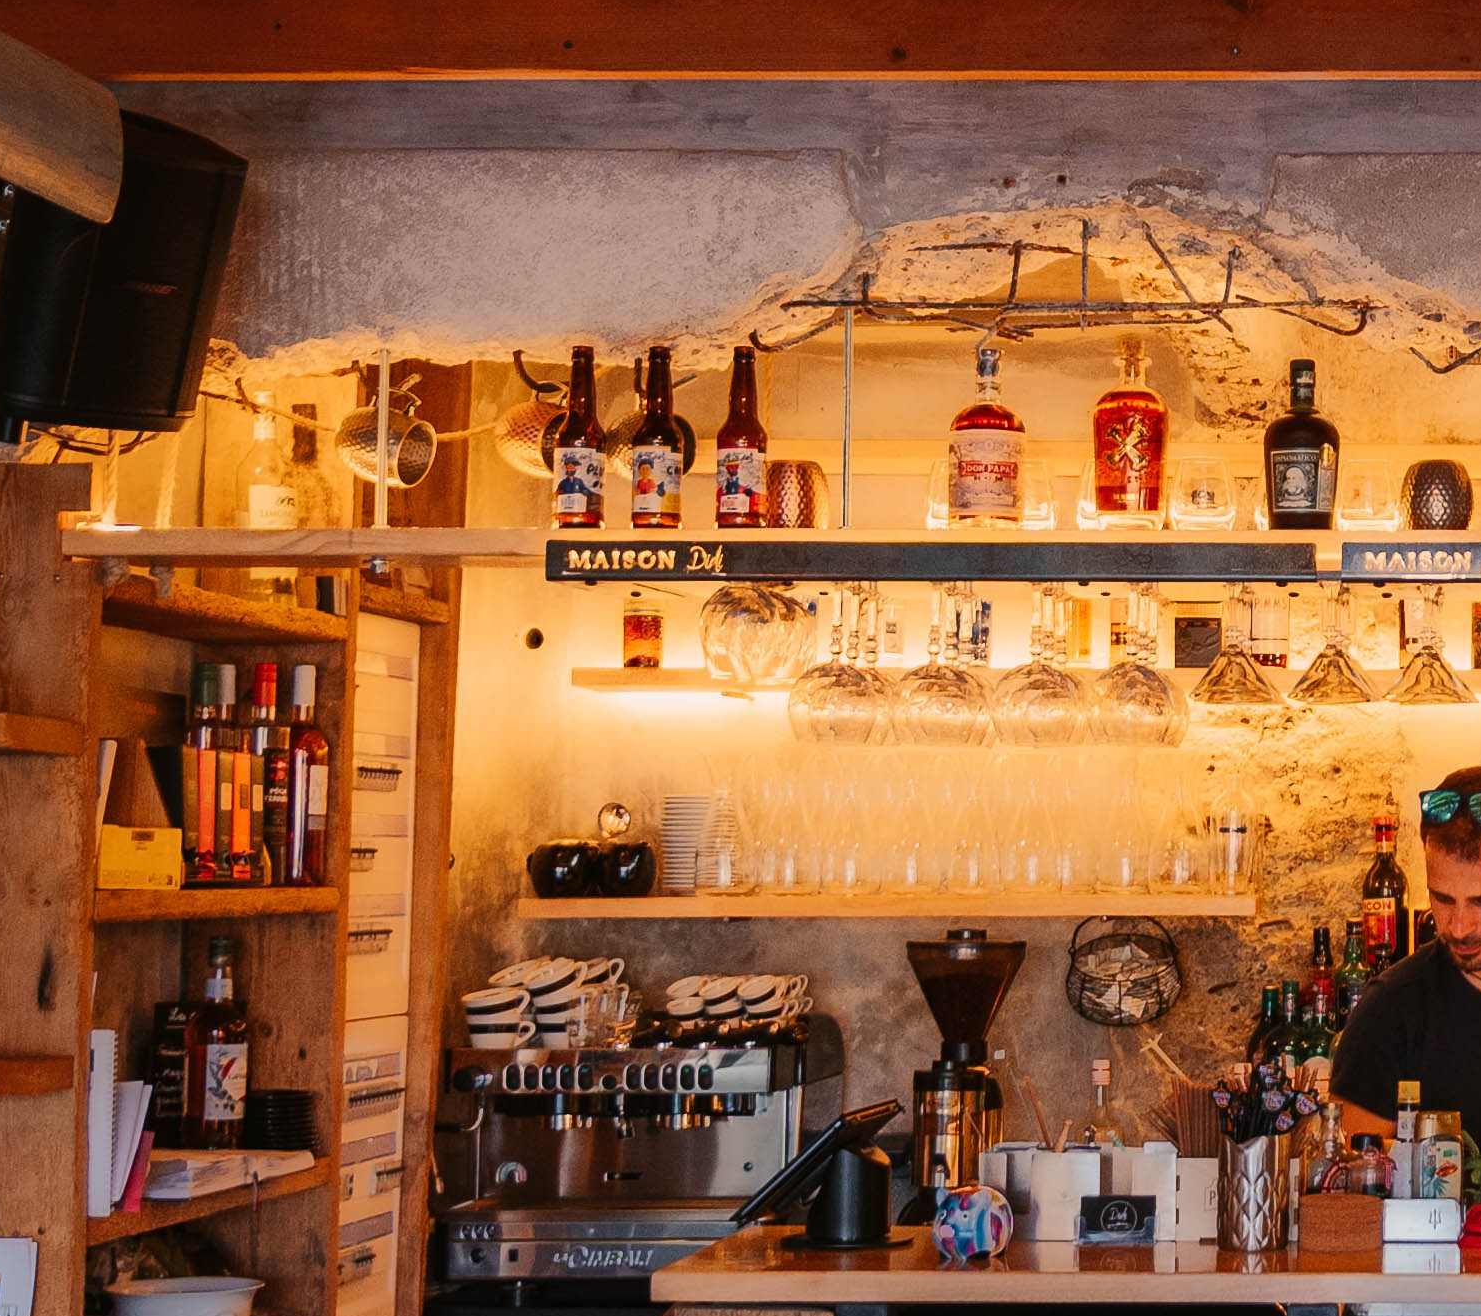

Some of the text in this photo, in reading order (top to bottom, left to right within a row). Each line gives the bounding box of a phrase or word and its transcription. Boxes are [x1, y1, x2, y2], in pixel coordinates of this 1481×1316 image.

[568, 549, 676, 570] MAISON
[1364, 550, 1472, 573] MAISON
[1363, 900, 1392, 911] ICON
